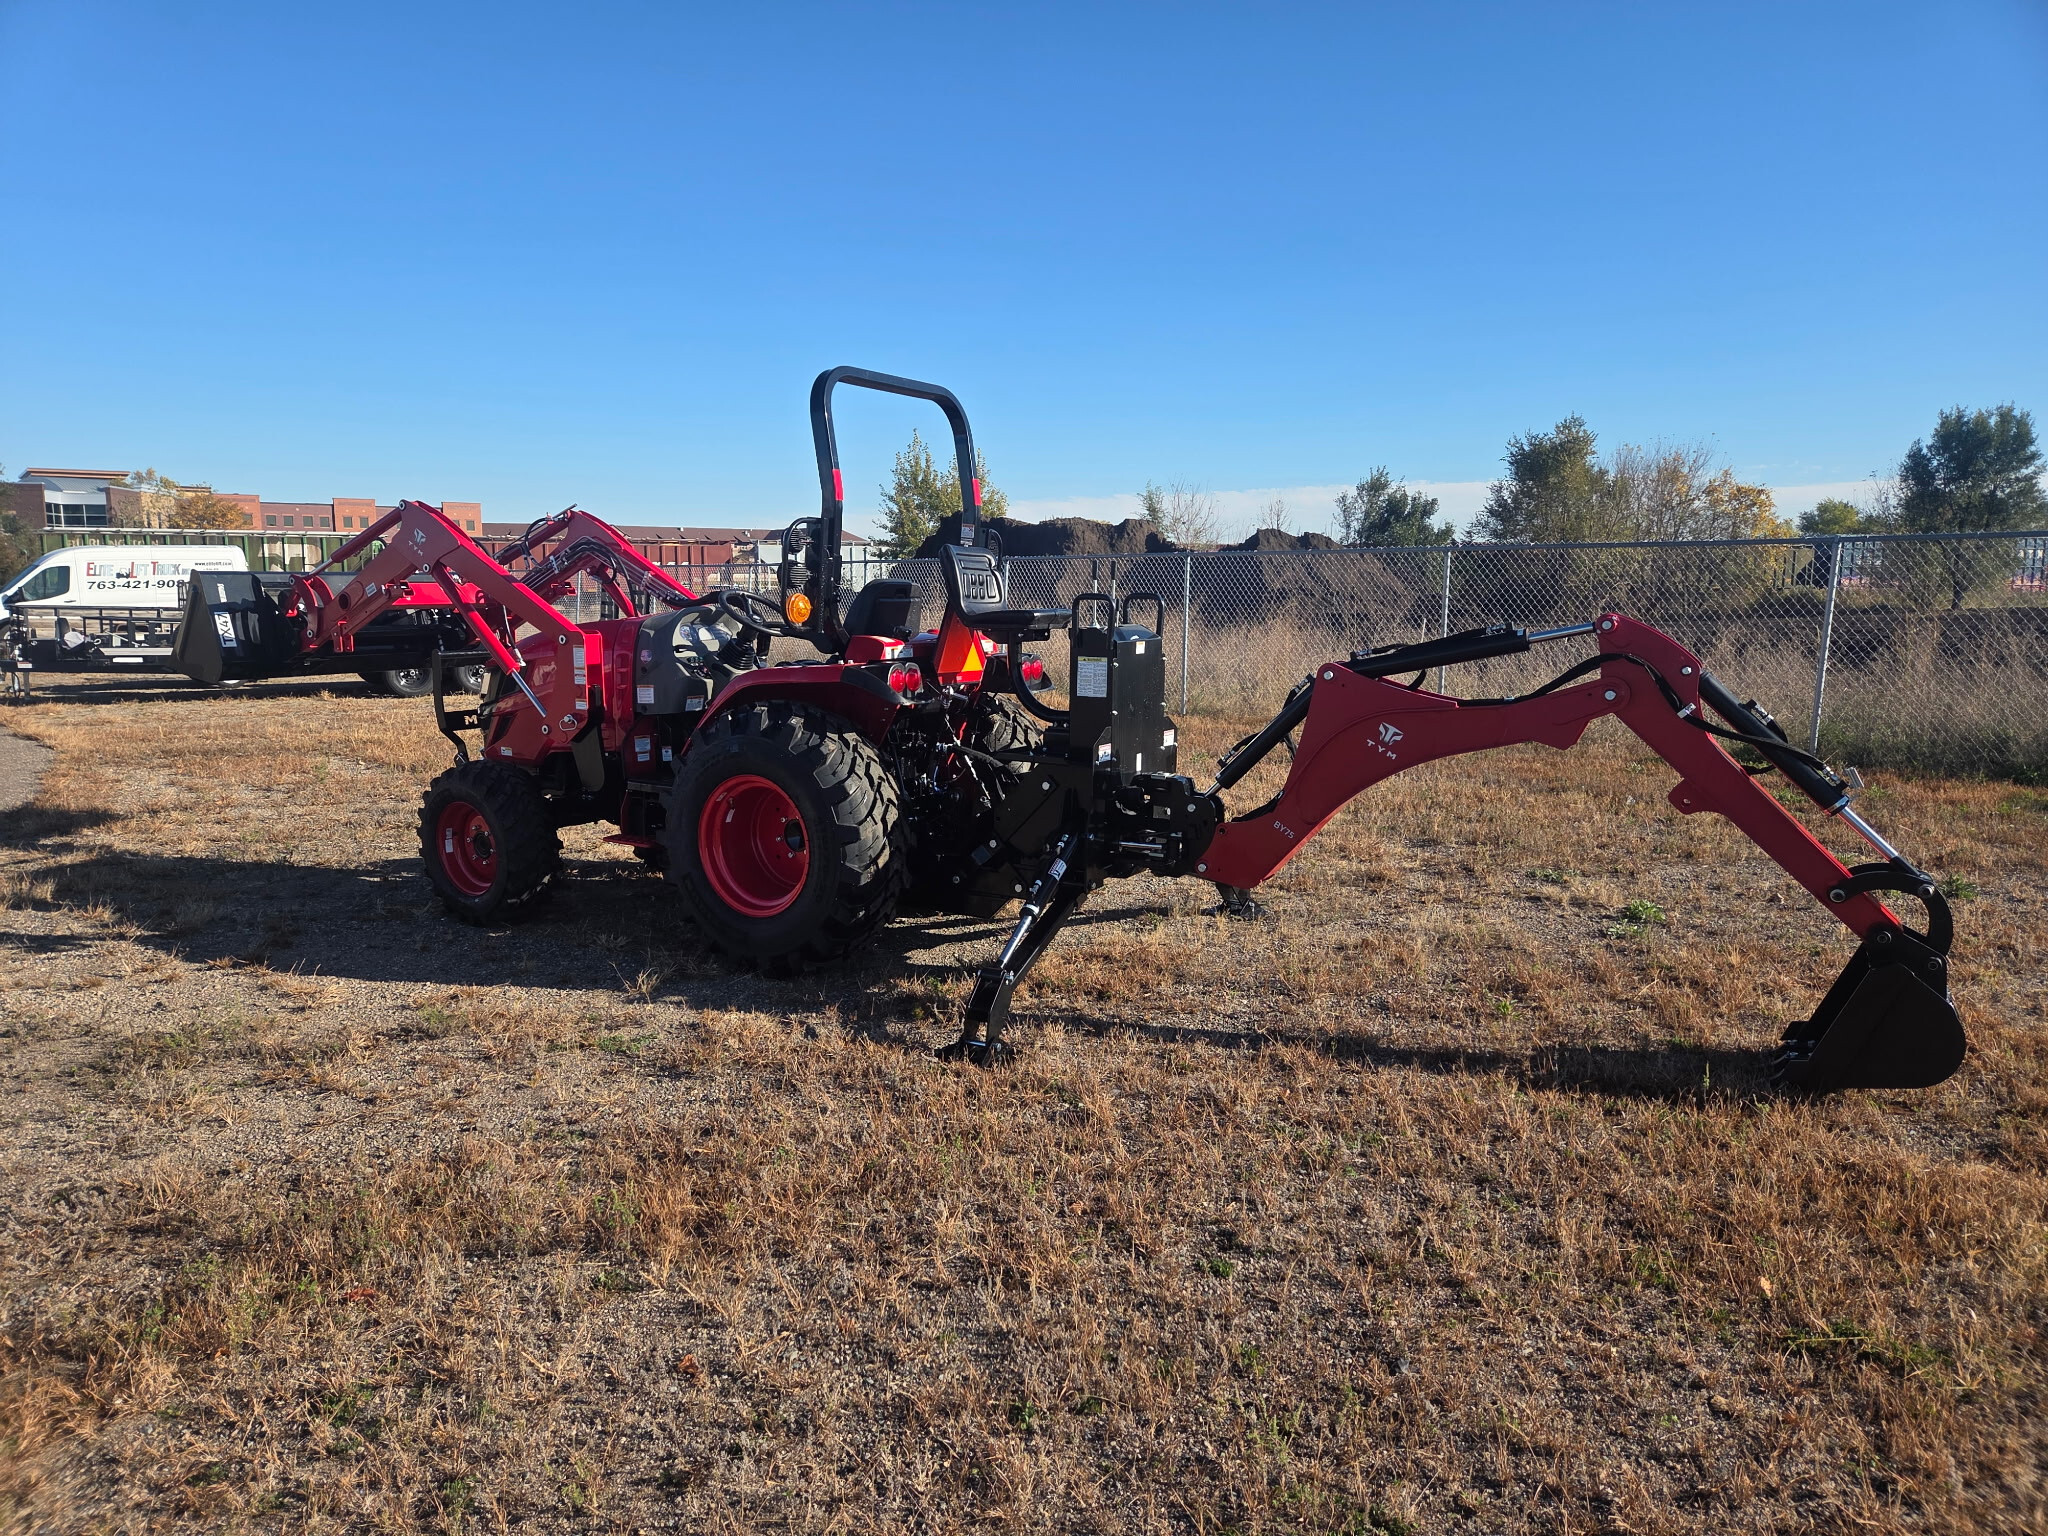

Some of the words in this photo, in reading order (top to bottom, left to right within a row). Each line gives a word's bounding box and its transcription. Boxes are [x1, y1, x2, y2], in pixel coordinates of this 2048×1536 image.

[129, 561, 150, 578] LIFT
[151, 561, 181, 576] TRUCK
[1366, 738, 1397, 760] TYM
[1273, 820, 1295, 839] BY75
